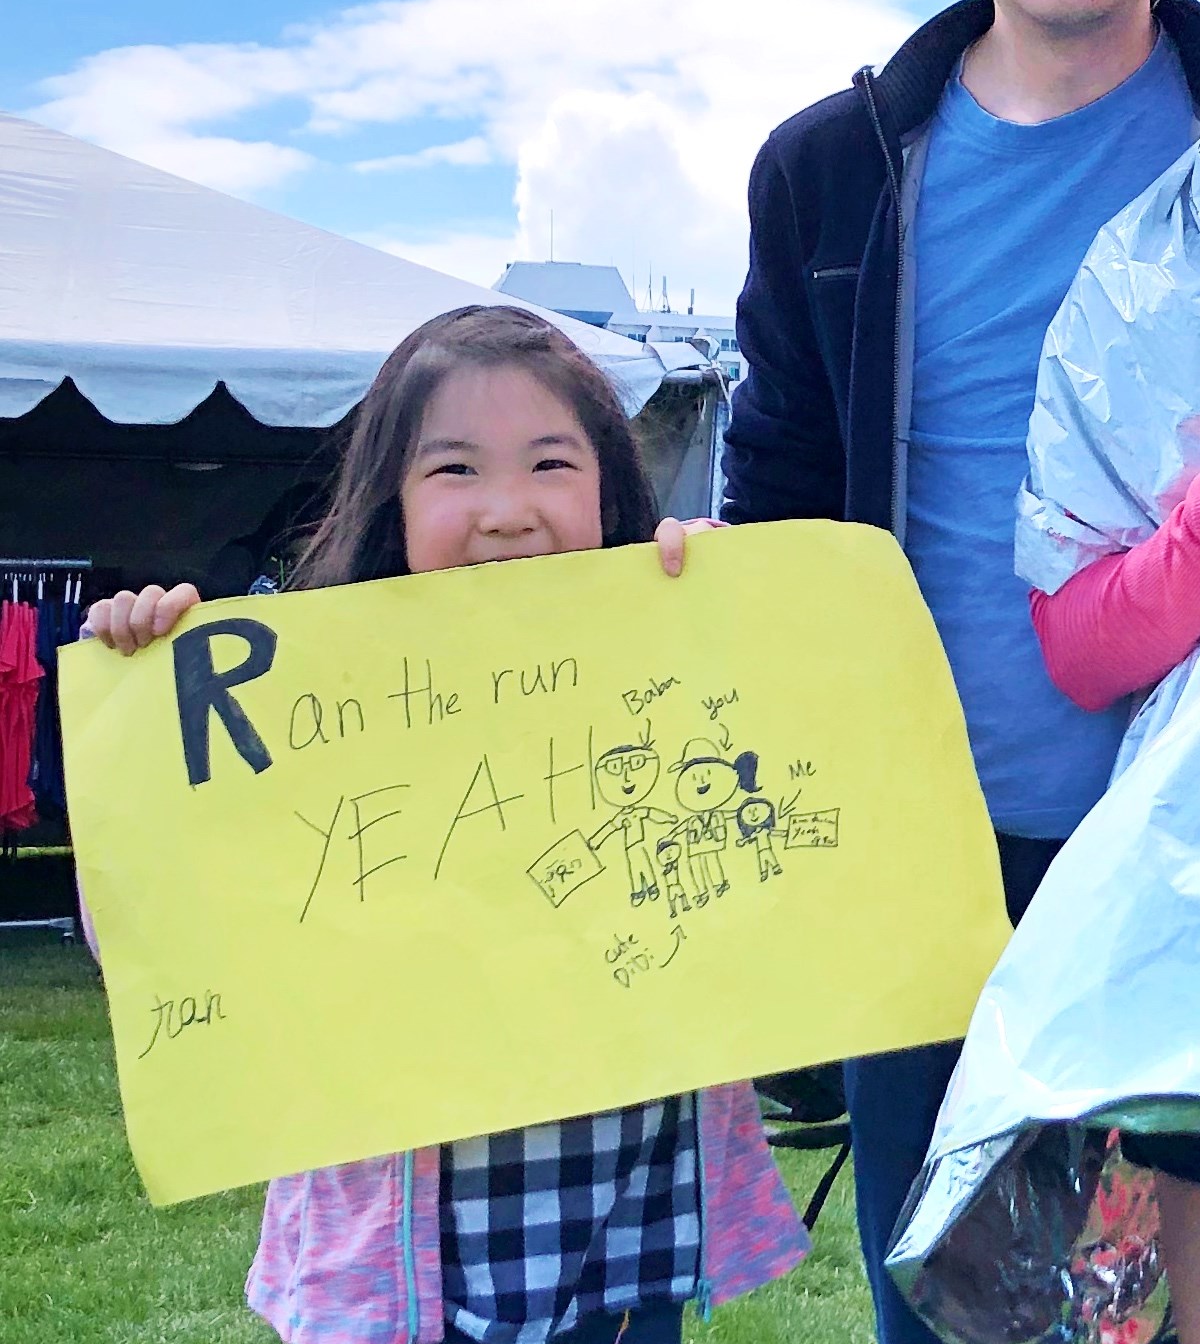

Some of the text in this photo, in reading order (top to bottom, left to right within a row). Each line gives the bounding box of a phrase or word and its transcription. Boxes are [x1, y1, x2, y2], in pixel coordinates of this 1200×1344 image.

[387, 656, 461, 728] the
[492, 657, 578, 704] run
[621, 676, 681, 715] Baba
[788, 759, 817, 780] Me
[294, 724, 597, 923] YEAH
[604, 932, 640, 964] cute
